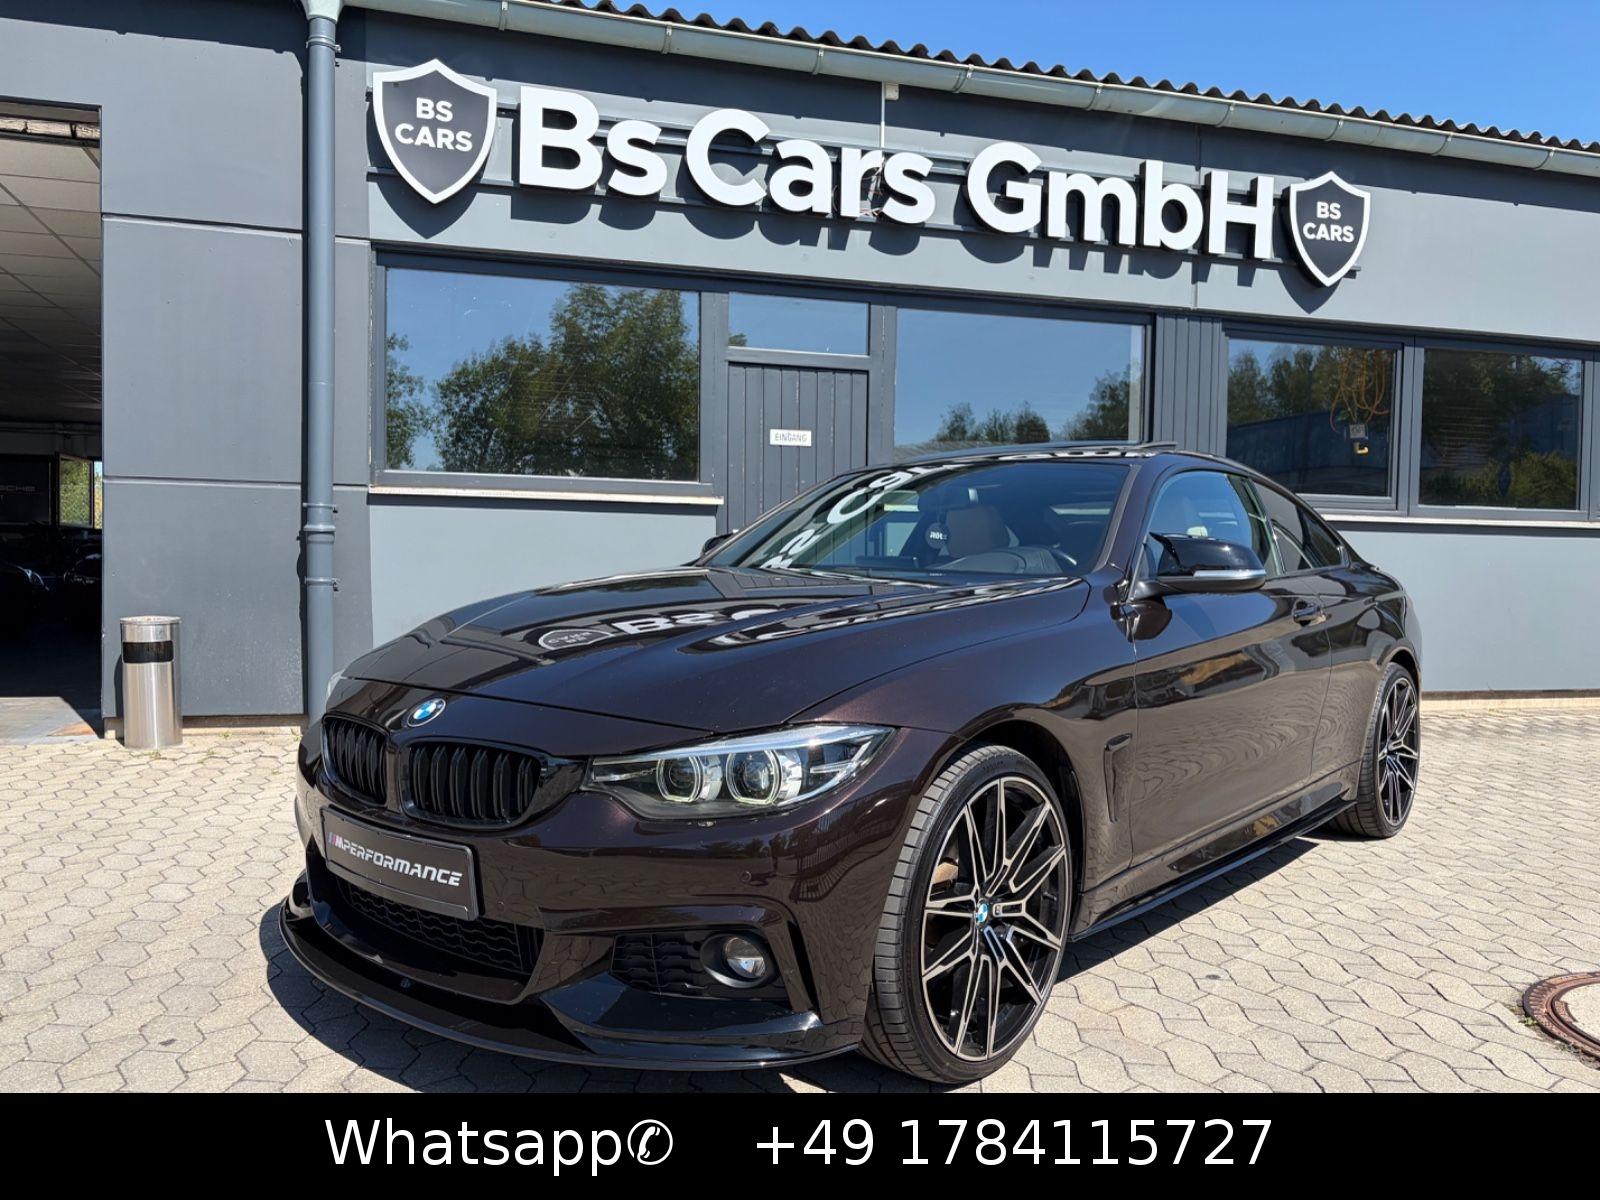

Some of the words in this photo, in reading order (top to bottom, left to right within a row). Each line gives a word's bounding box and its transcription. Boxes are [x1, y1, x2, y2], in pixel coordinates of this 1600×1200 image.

[415, 96, 454, 122] BS
[394, 122, 473, 153] CARS
[967, 141, 1275, 260] GmbH
[1316, 200, 1342, 220] BS
[1302, 222, 1355, 244] CARS
